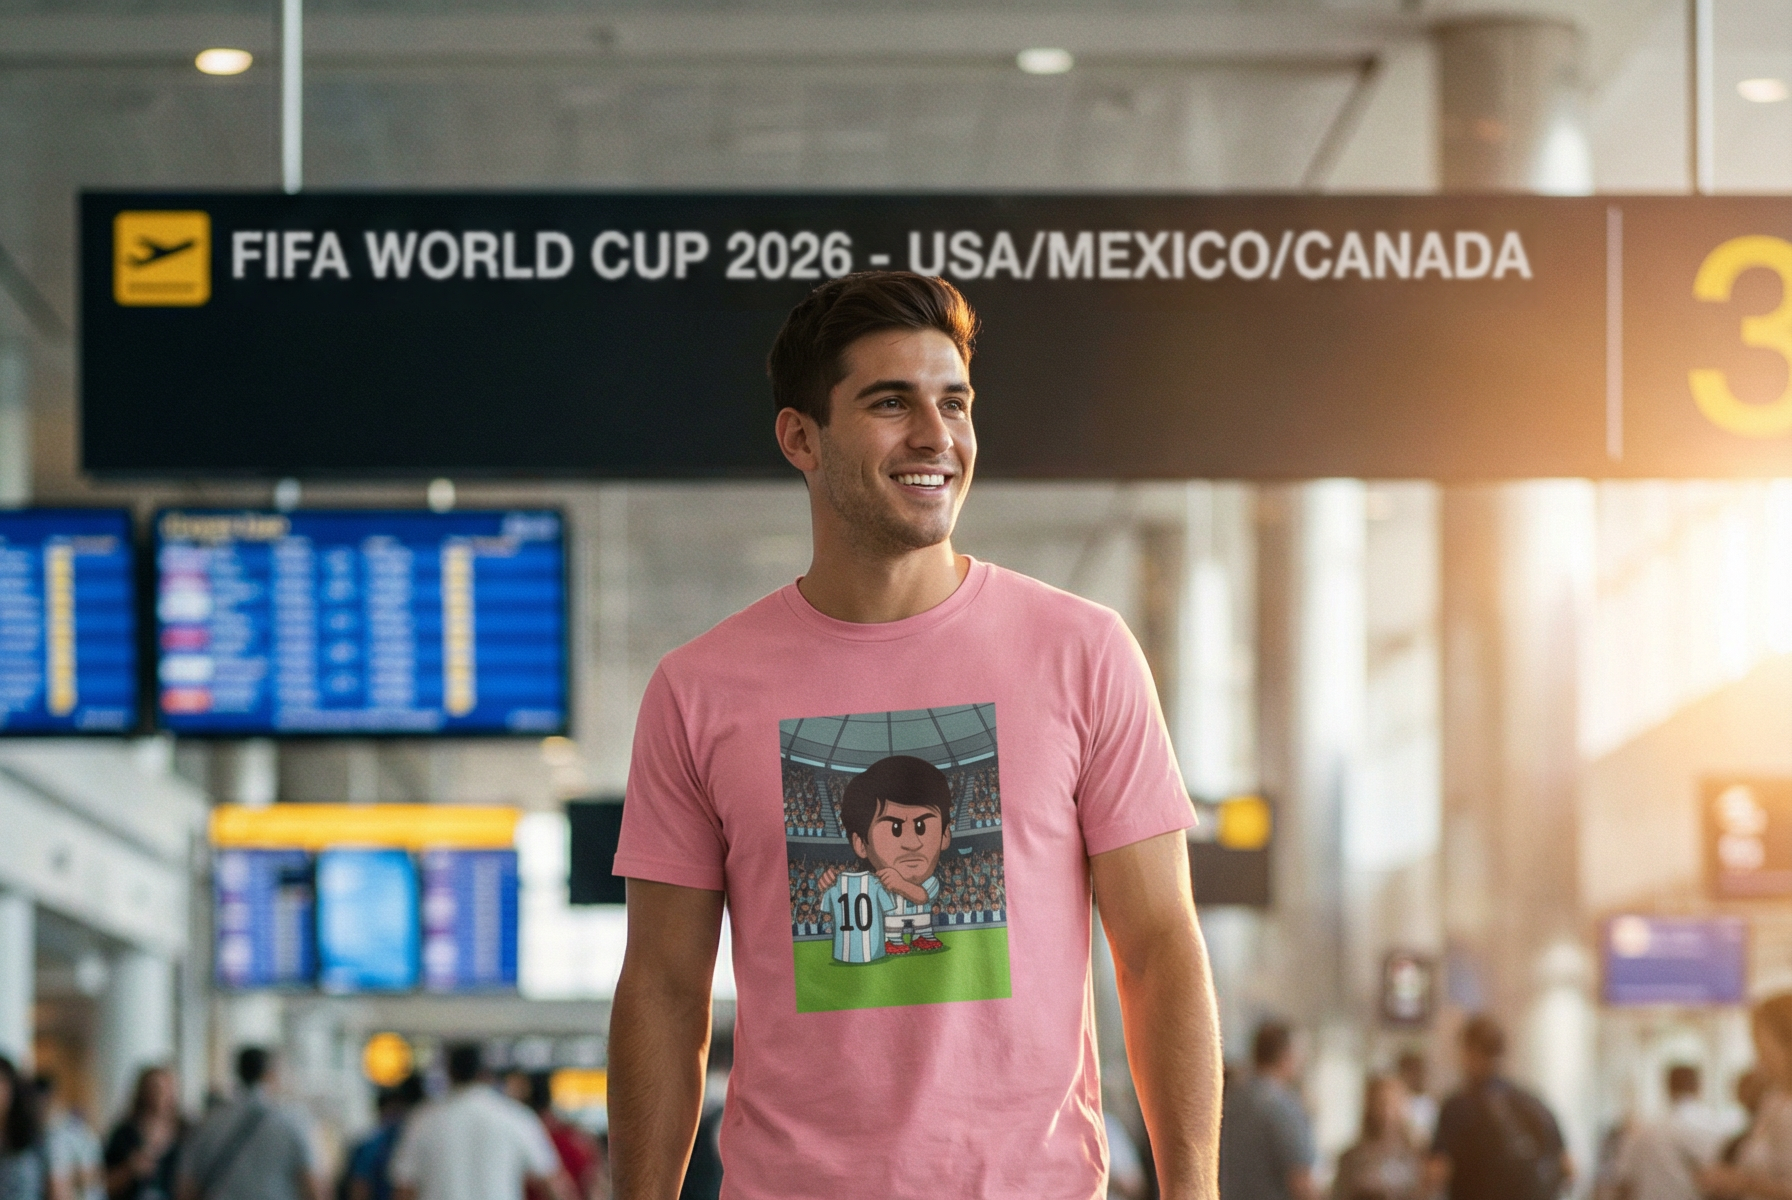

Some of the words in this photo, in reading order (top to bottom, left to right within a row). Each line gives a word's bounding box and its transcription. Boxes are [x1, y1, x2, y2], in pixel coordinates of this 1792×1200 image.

[232, 230, 349, 279] FIFA
[365, 230, 574, 280] WORLD
[591, 230, 708, 280] CUP
[726, 230, 852, 280] 2026
[869, 254, 890, 265] -
[909, 230, 1531, 280] USA/MEXICO/CANADA
[1690, 237, 1792, 436] 3
[837, 892, 873, 931] 10
